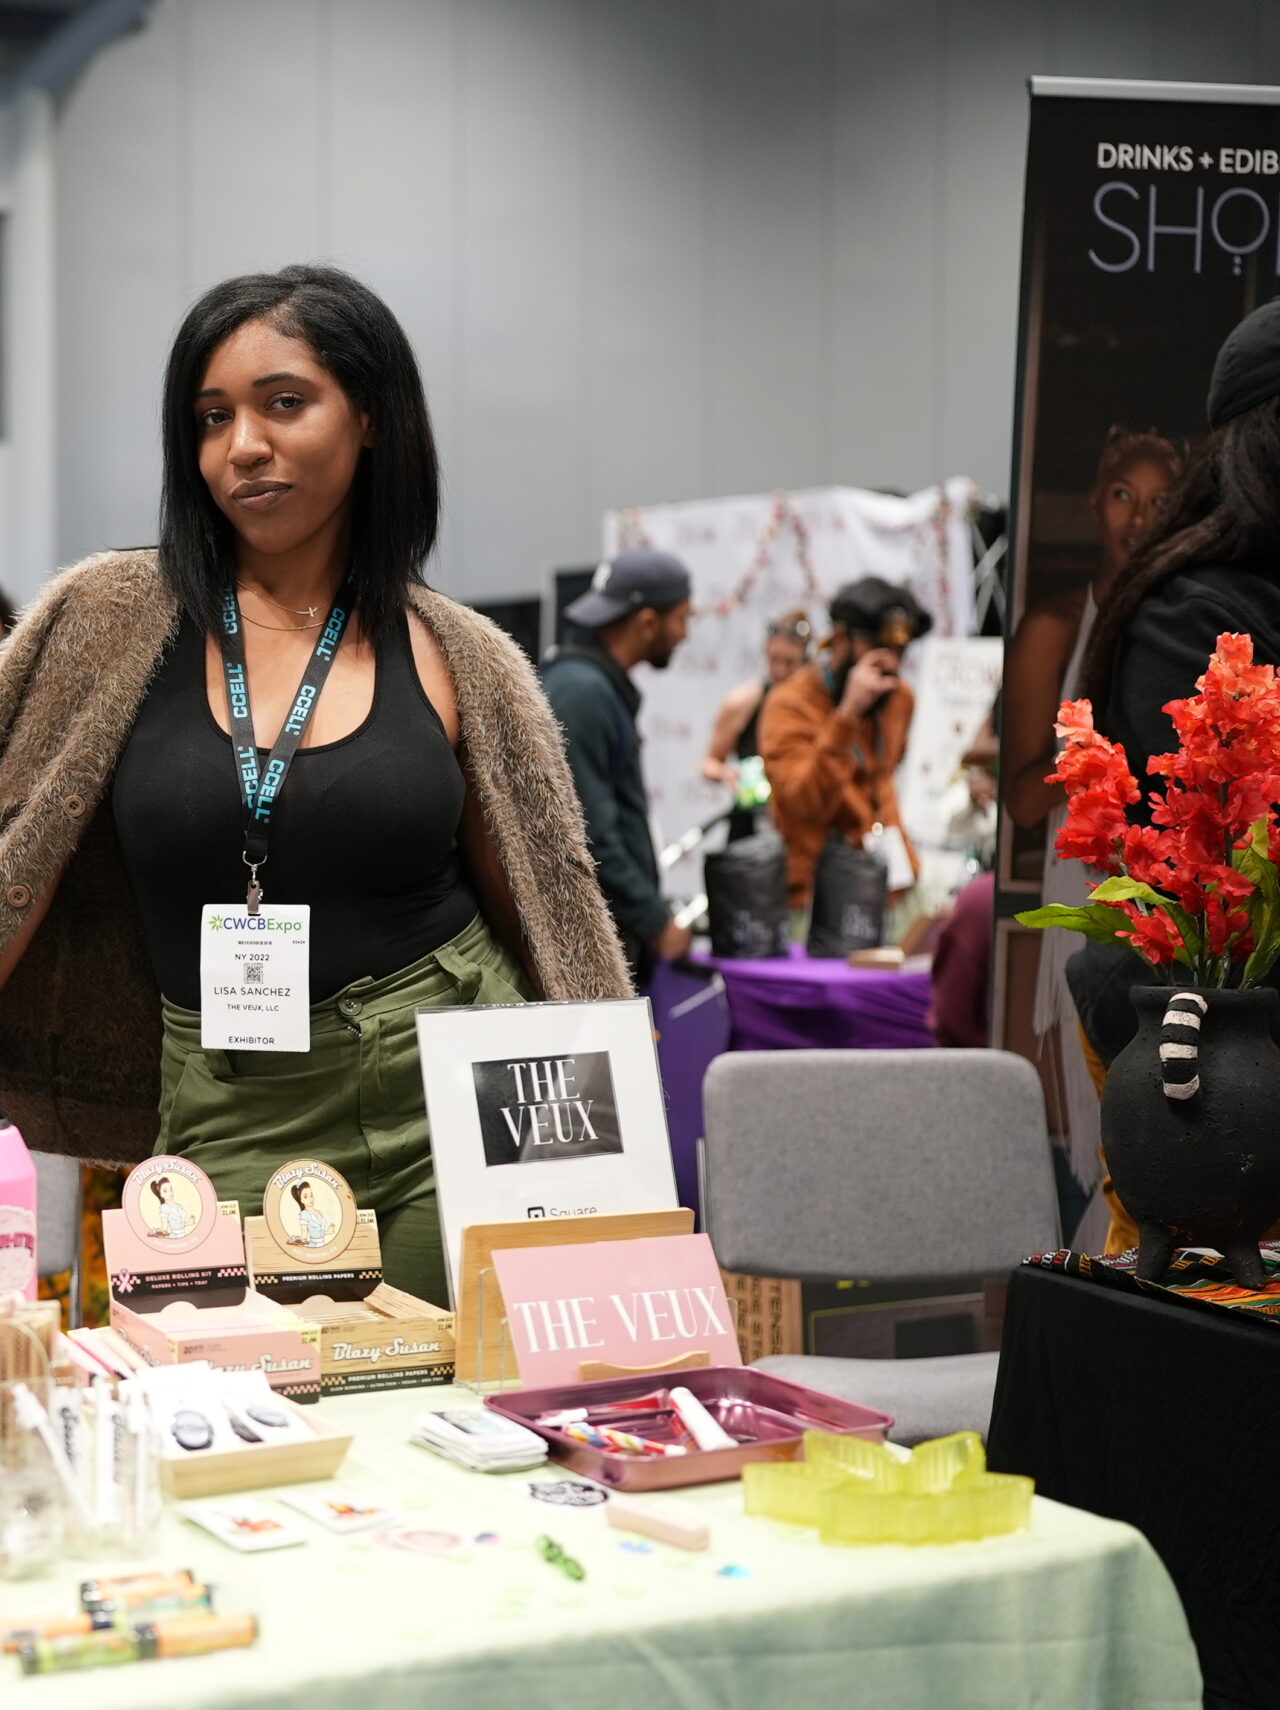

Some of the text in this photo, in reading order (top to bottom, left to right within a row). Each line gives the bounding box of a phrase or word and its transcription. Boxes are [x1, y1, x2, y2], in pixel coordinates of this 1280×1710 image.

[1096, 142, 1195, 173] DRINKS
[316, 607, 345, 657] CCELL
[228, 663, 248, 718] CCELL
[285, 684, 317, 733] CCELL
[254, 758, 285, 821] CCELL
[223, 917, 302, 934] CWCBExpo
[234, 953, 270, 961] NY 2022
[214, 986, 291, 997] LISA SANCHEZ
[227, 1003, 241, 1011] THE
[228, 1035, 275, 1045] EXHIBITOR
[506, 1058, 581, 1104] THE
[499, 1099, 600, 1148] VEUX
[133, 1158, 199, 1186] Blazy Susan
[273, 1161, 342, 1190] Blazy Susan
[145, 1274, 171, 1282] DELUXE
[172, 1272, 200, 1280] ROLLING
[282, 1272, 355, 1282] PREMIUM ROLLING PAPERS
[512, 1297, 605, 1354] THE
[608, 1286, 728, 1343] VEUX
[251, 1354, 313, 1373] Susan
[331, 1337, 441, 1363] Blazy Susan
[347, 1369, 428, 1383] PREMIUM ROLLING PAPERS
